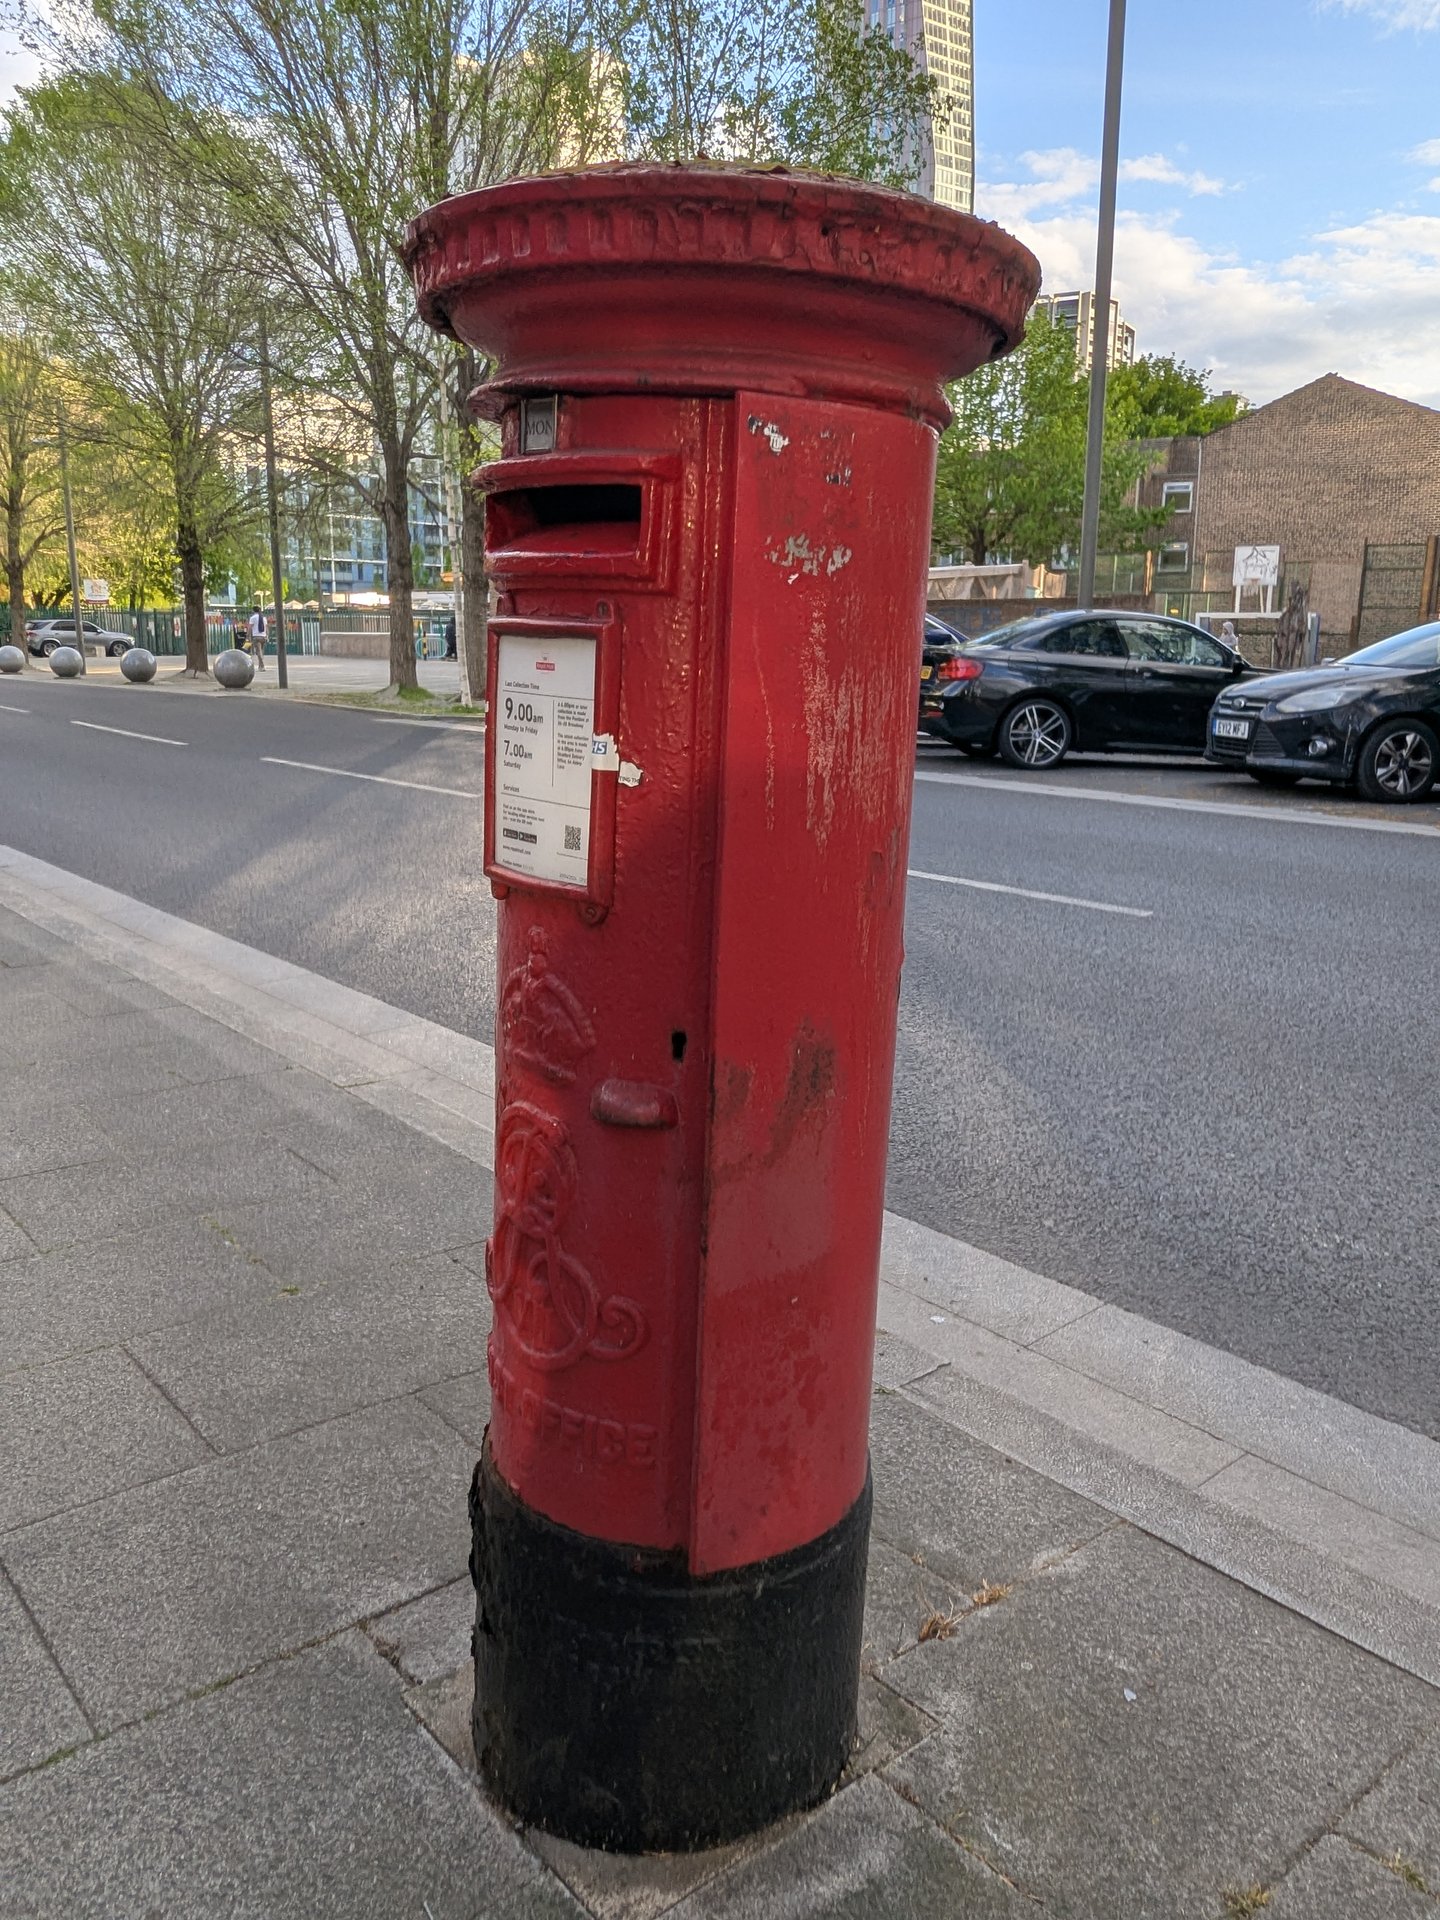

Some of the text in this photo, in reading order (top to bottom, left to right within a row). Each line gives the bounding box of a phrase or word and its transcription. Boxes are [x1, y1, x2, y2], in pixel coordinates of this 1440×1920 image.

[505, 697, 544, 724] 9.00am
[503, 723, 519, 733] Monday
[525, 725, 538, 736] Friday
[503, 739, 533, 760] 7.00am
[503, 759, 522, 771] Saturday
[503, 783, 521, 794] Services
